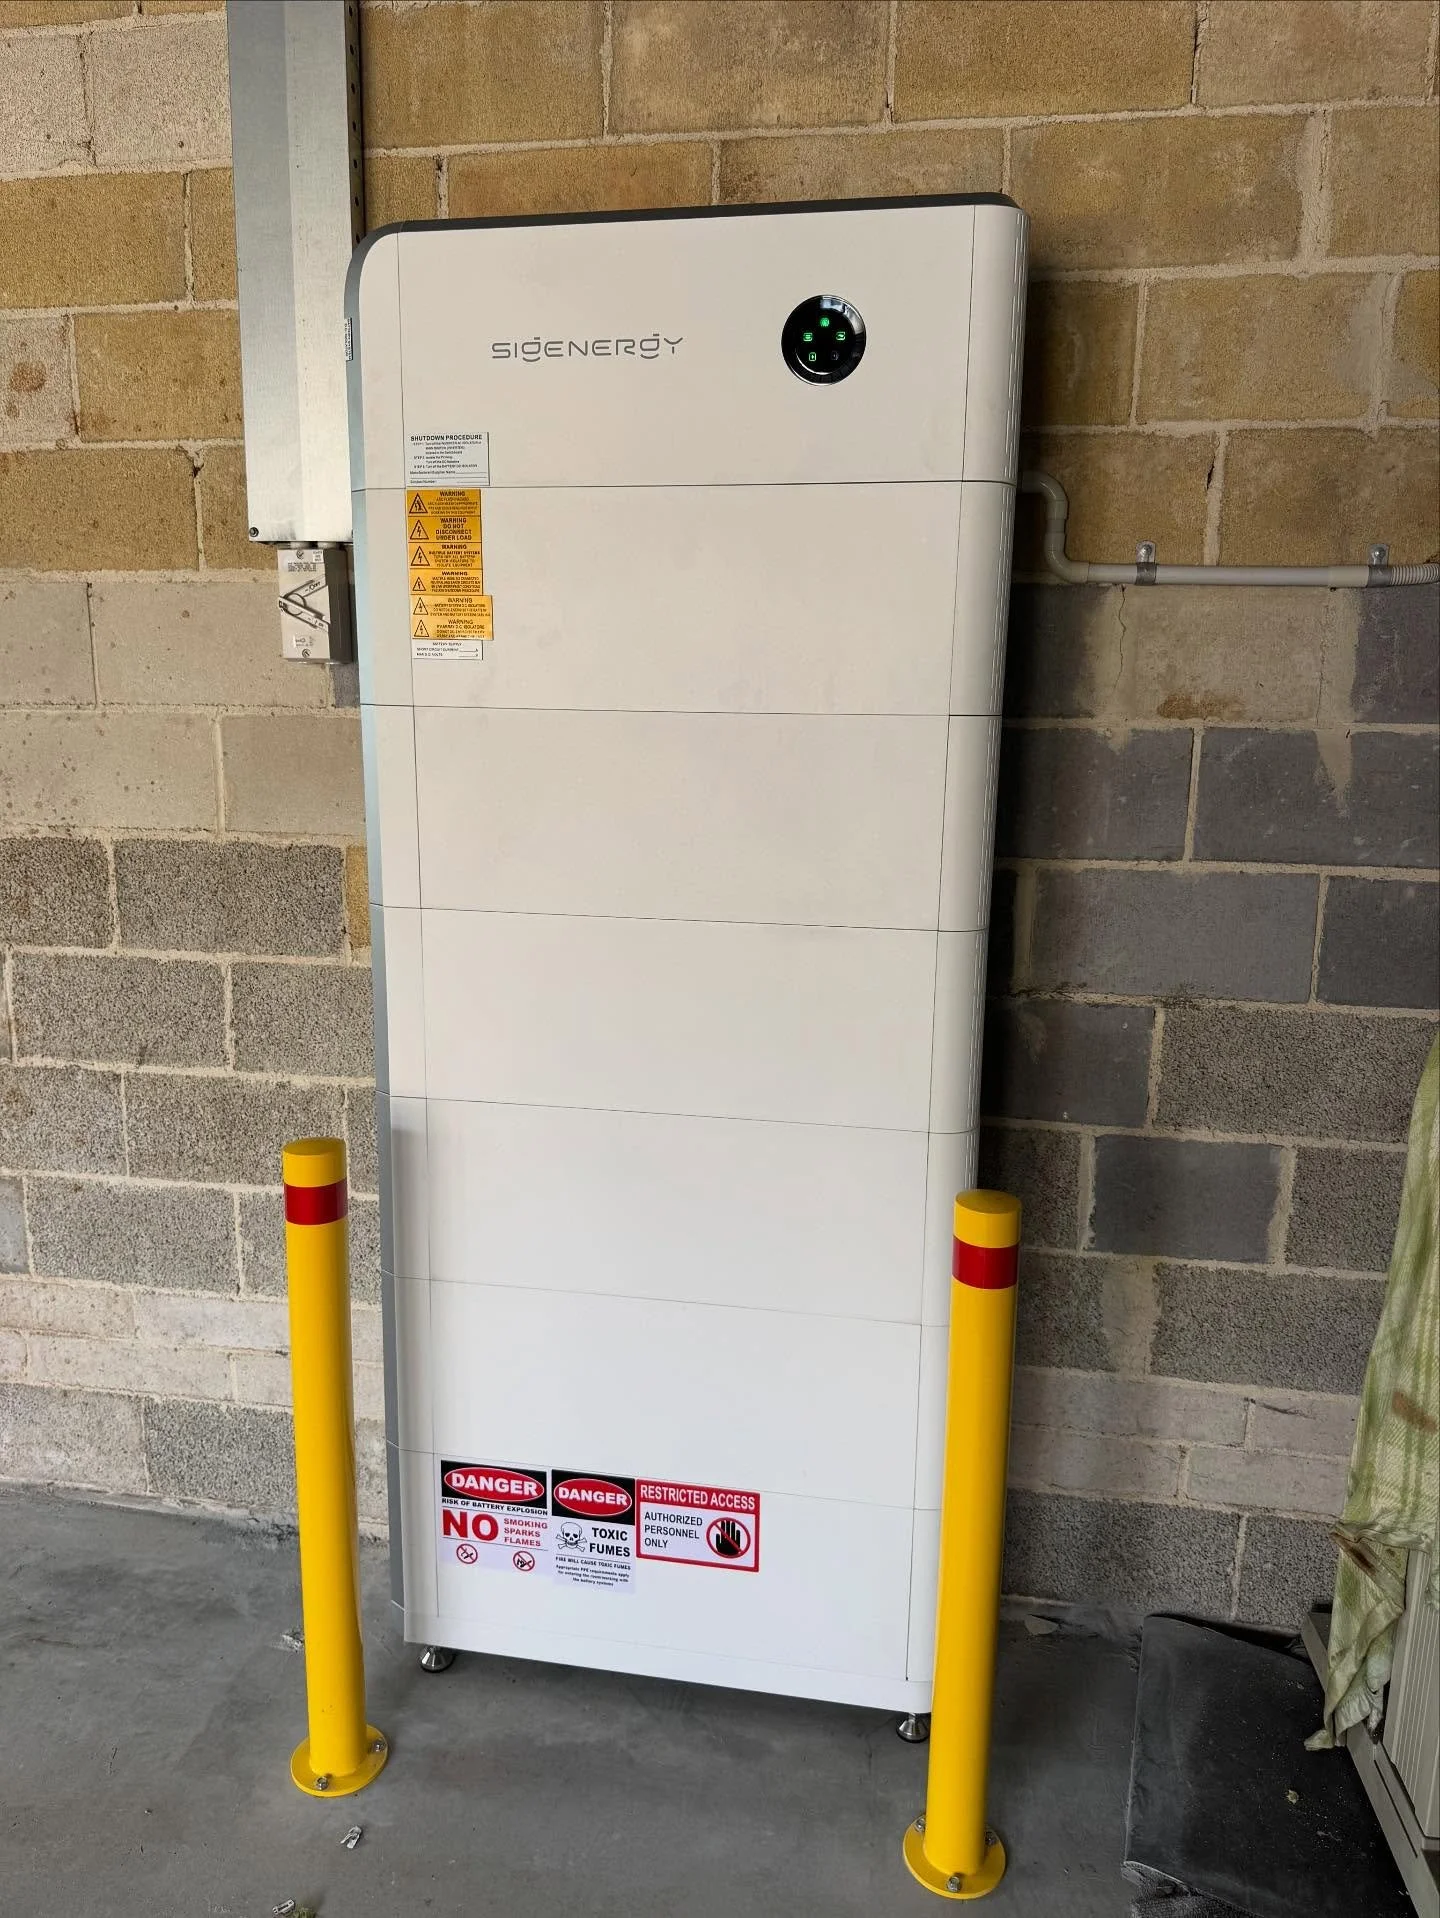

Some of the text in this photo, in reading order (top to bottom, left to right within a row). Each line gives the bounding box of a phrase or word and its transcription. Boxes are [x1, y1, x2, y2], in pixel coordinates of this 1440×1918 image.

[451, 1473, 538, 1496] DANGER
[558, 1487, 628, 1506] DANGER
[641, 1485, 755, 1510] RESTRICTED ACCESS
[473, 1501, 504, 1511] BATTERY
[507, 1506, 548, 1515] EXPLOSION
[443, 1509, 499, 1541] NO
[504, 1518, 548, 1529] SMOKING
[644, 1512, 702, 1526] AUTHORIZED
[504, 1527, 540, 1537] SPARKS
[592, 1527, 628, 1541] TOXIC
[645, 1525, 699, 1539] PERSONNEL
[504, 1537, 541, 1547] FLAMES
[645, 1538, 668, 1548] ONLY
[589, 1543, 630, 1557] FUMES
